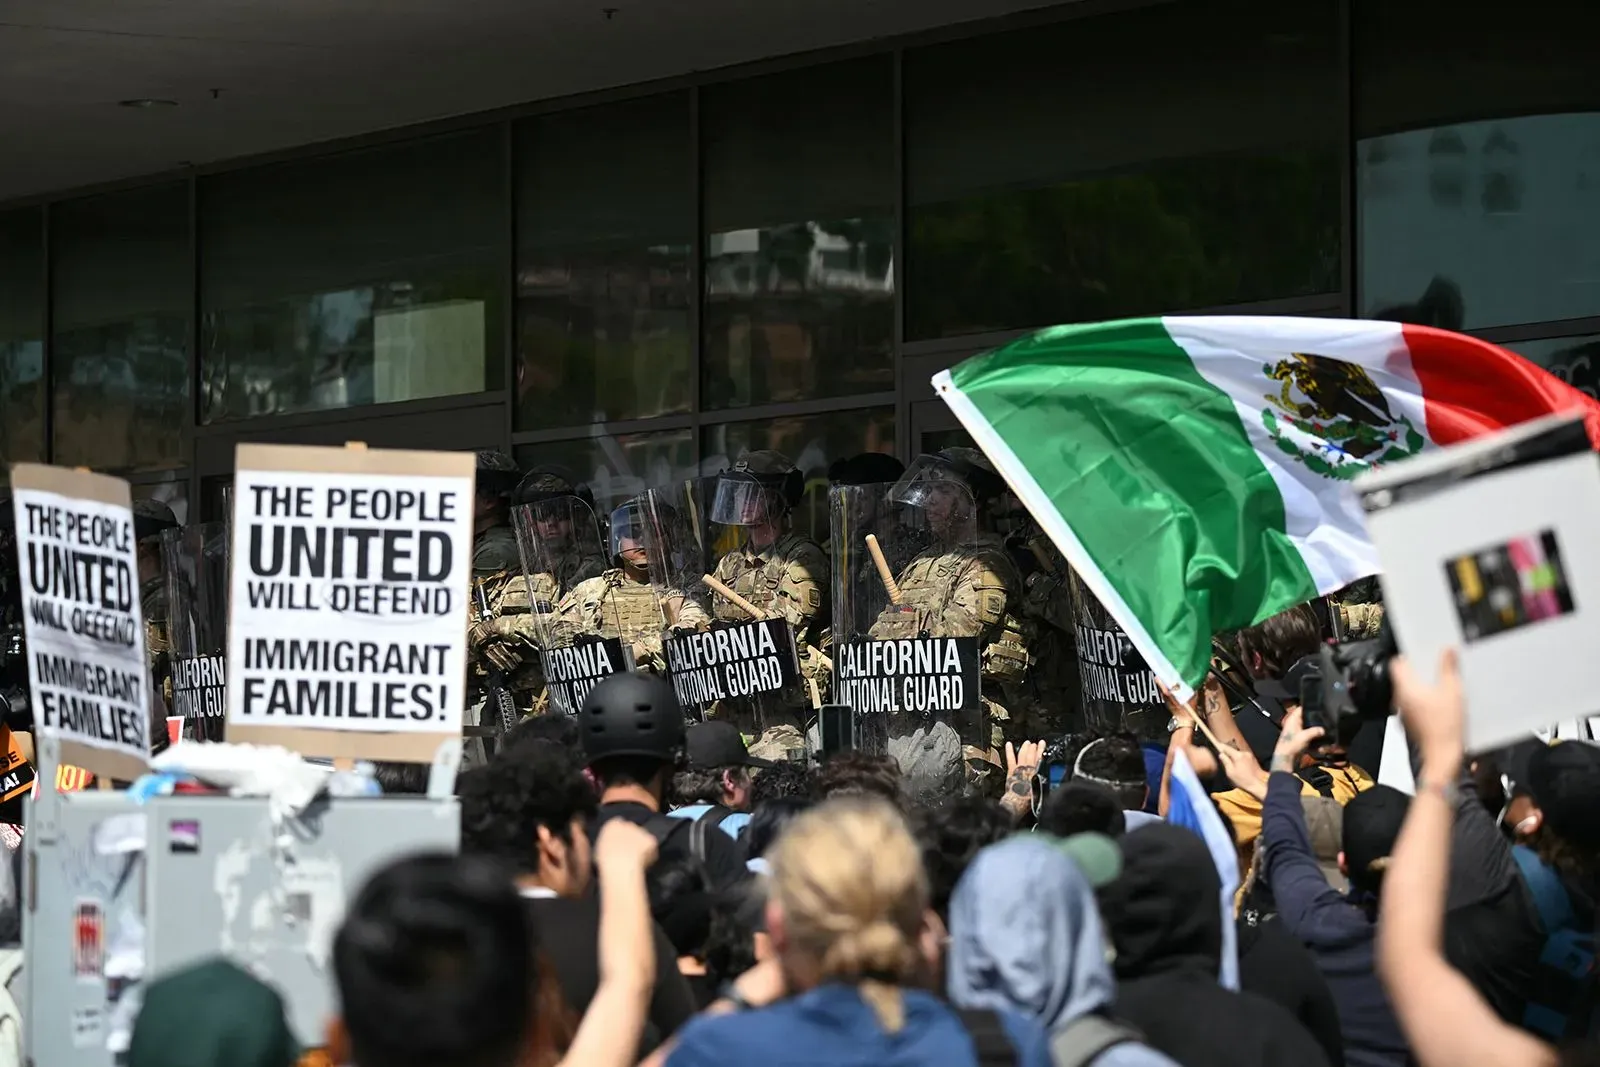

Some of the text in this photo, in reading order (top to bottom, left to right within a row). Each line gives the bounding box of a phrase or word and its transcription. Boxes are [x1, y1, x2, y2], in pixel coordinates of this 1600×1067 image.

[249, 486, 457, 523] THE PEOPLE
[25, 503, 131, 553] THE PEOPLE
[249, 524, 453, 583] UNITED
[28, 541, 132, 613] UNITED
[248, 581, 452, 616] WILL DEFEND
[30, 597, 135, 649] WILL DEFEND
[244, 638, 452, 676] IMMIGRANT
[665, 621, 777, 674] CALIFORNIA
[839, 639, 962, 679] CALIFORNIA
[171, 656, 226, 689] ALIFORN
[672, 655, 783, 707] NATIONAL GUARD
[1125, 670, 1165, 704] GUA
[243, 678, 447, 721] FAMILIES!
[840, 675, 963, 714] NATIONAL GUARD
